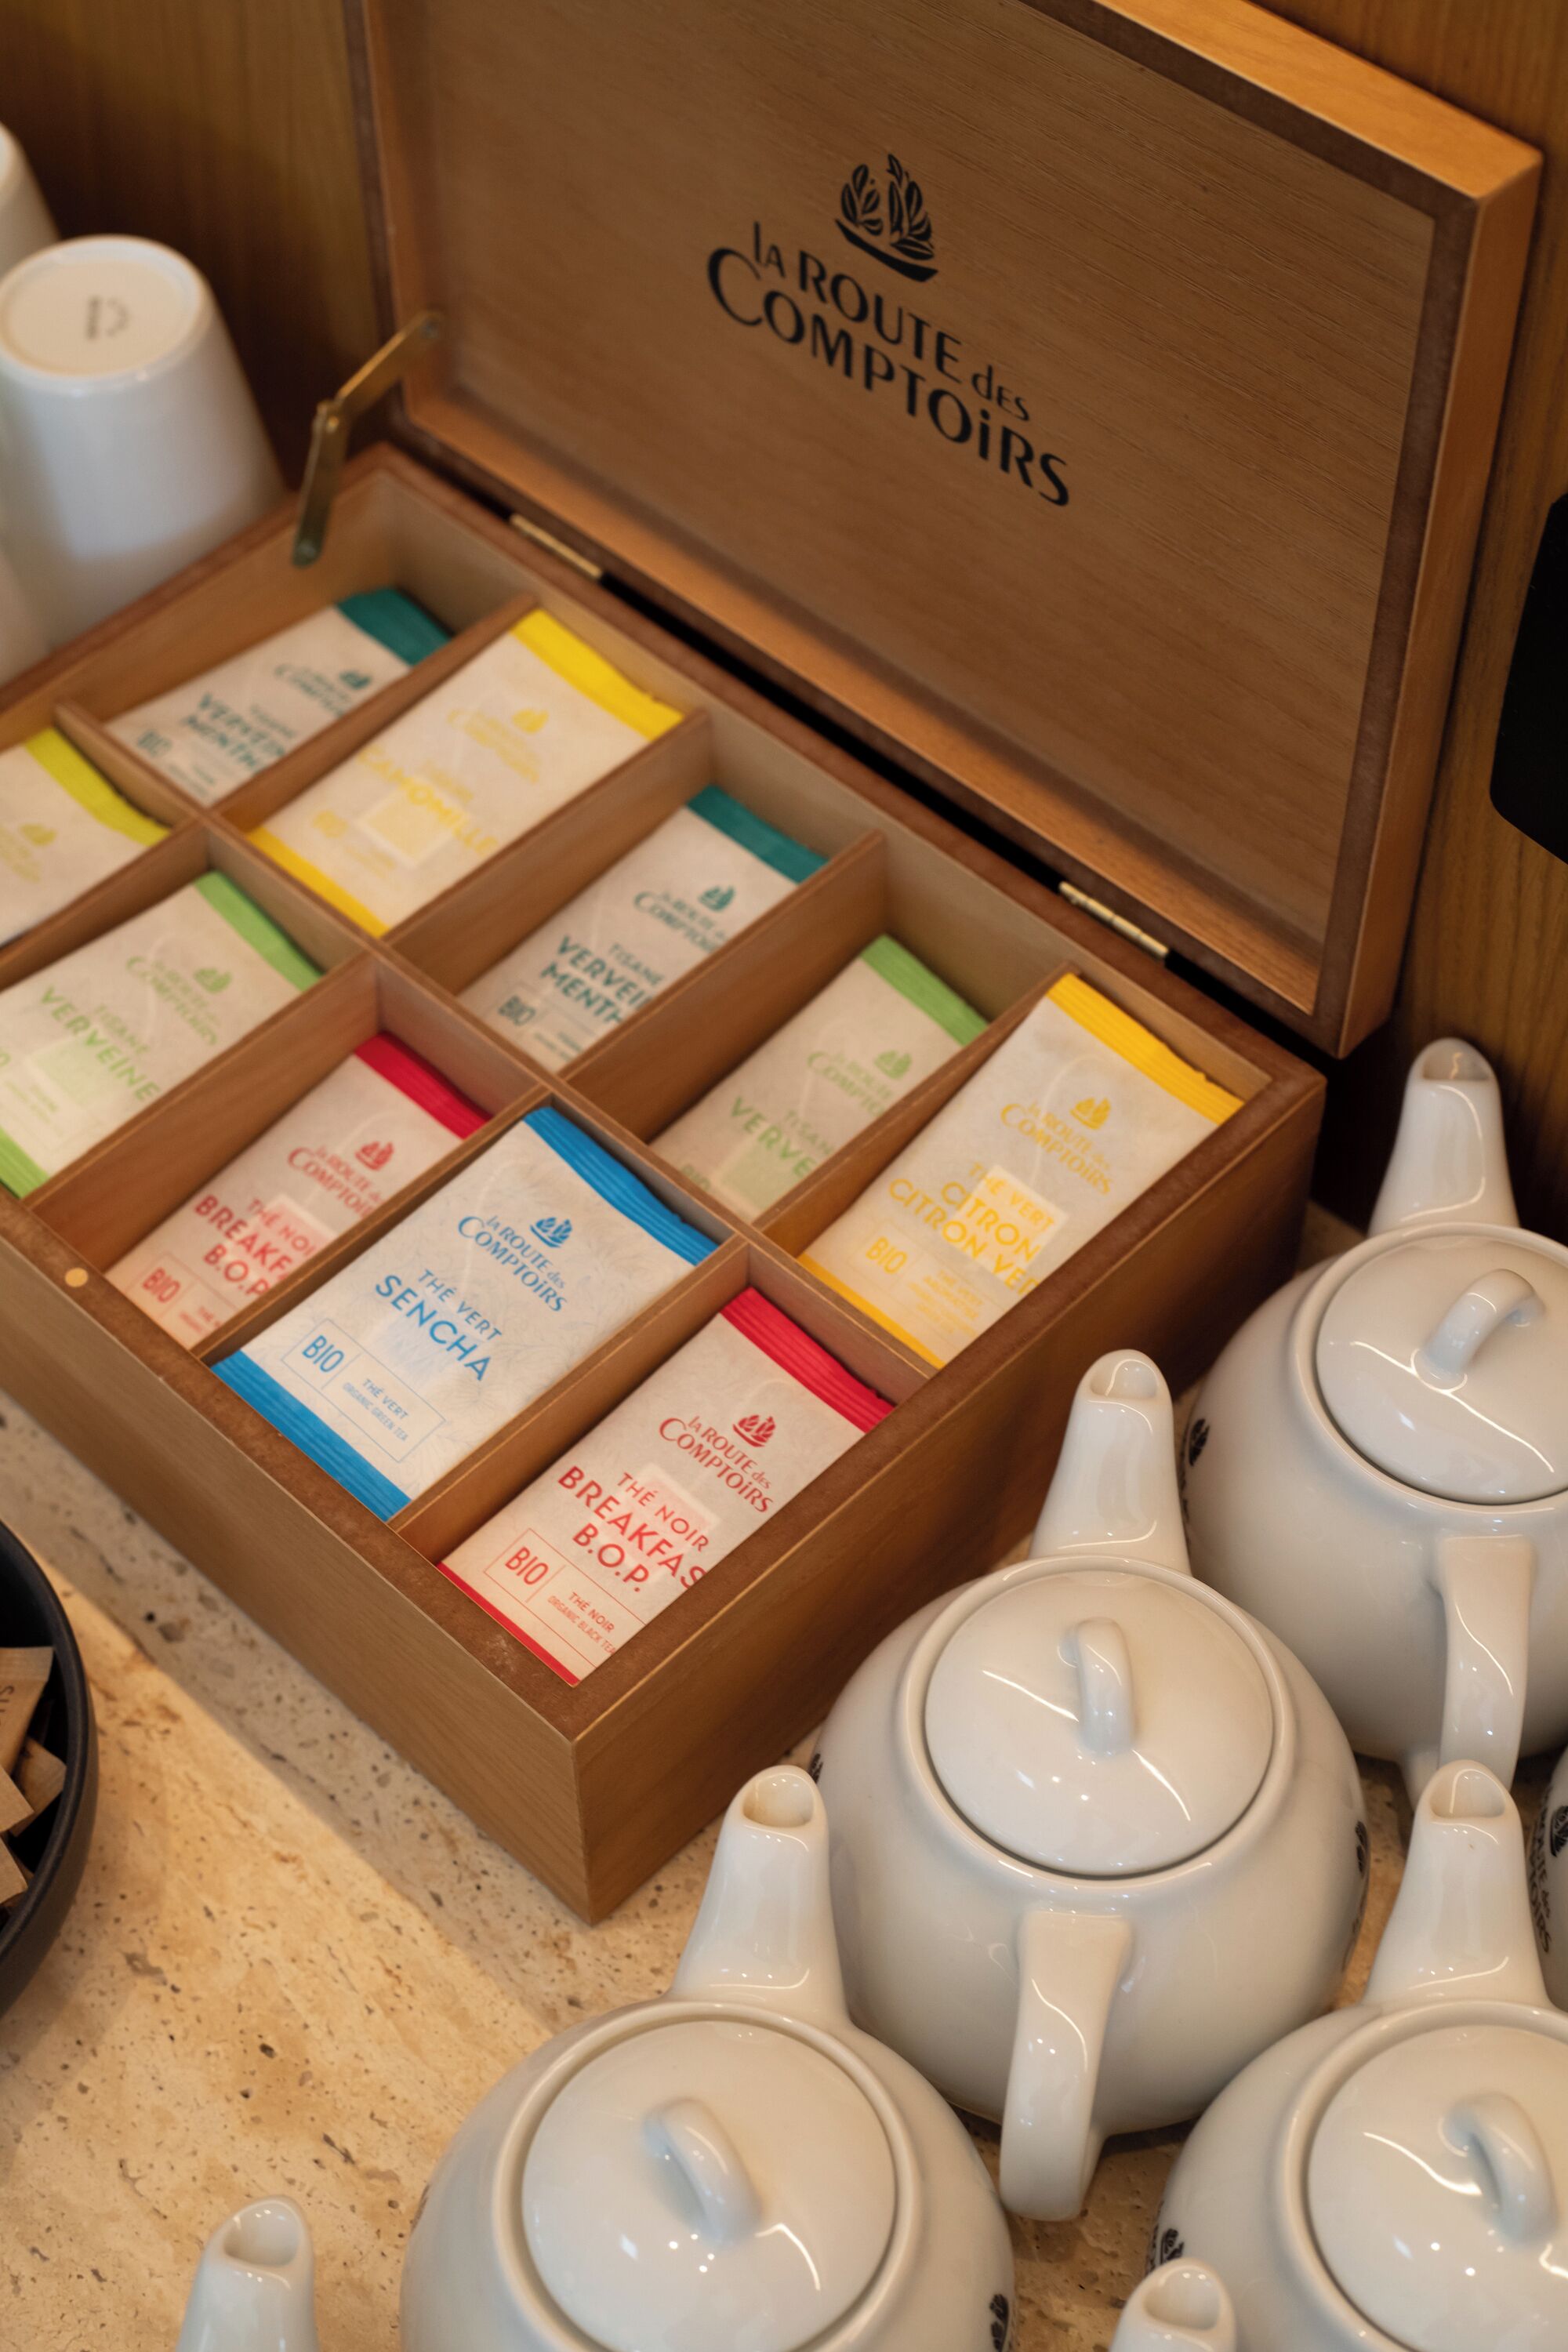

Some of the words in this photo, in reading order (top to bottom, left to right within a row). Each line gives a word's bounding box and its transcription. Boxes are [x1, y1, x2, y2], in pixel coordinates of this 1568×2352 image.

[798, 249, 962, 383] ROUTE
[41, 984, 161, 1102] VERVEINE
[729, 1096, 818, 1178] VERVE
[1041, 1112, 1093, 1155] ROUTE
[888, 1178, 988, 1260] CITRON
[941, 1181, 1041, 1262] CITRON
[1009, 1190, 1055, 1232] VERT
[498, 1225, 554, 1273] ROUTE
[865, 1236, 908, 1275] BIO
[141, 1266, 181, 1304] BIO
[418, 1269, 458, 1303] THÉ
[456, 1300, 503, 1342] VERT
[375, 1273, 492, 1381] SENCHA
[302, 1334, 345, 1374] BIO
[342, 1381, 374, 1411] ORGANIC
[370, 1405, 396, 1431] GREEN
[392, 1424, 409, 1442] TEA
[362, 1377, 385, 1399] THÉ
[381, 1395, 409, 1421] VERT
[700, 1426, 758, 1475] ROUTE
[616, 1472, 659, 1508] THÉ
[653, 1504, 710, 1552] NOIR
[504, 1546, 550, 1586] BIO
[572, 1522, 650, 1593] B.O.P.
[547, 1595, 581, 1624] ORGANIC
[577, 1619, 605, 1644] BLACK
[568, 1591, 591, 1612] THÉ
[588, 1607, 615, 1633] NOIR
